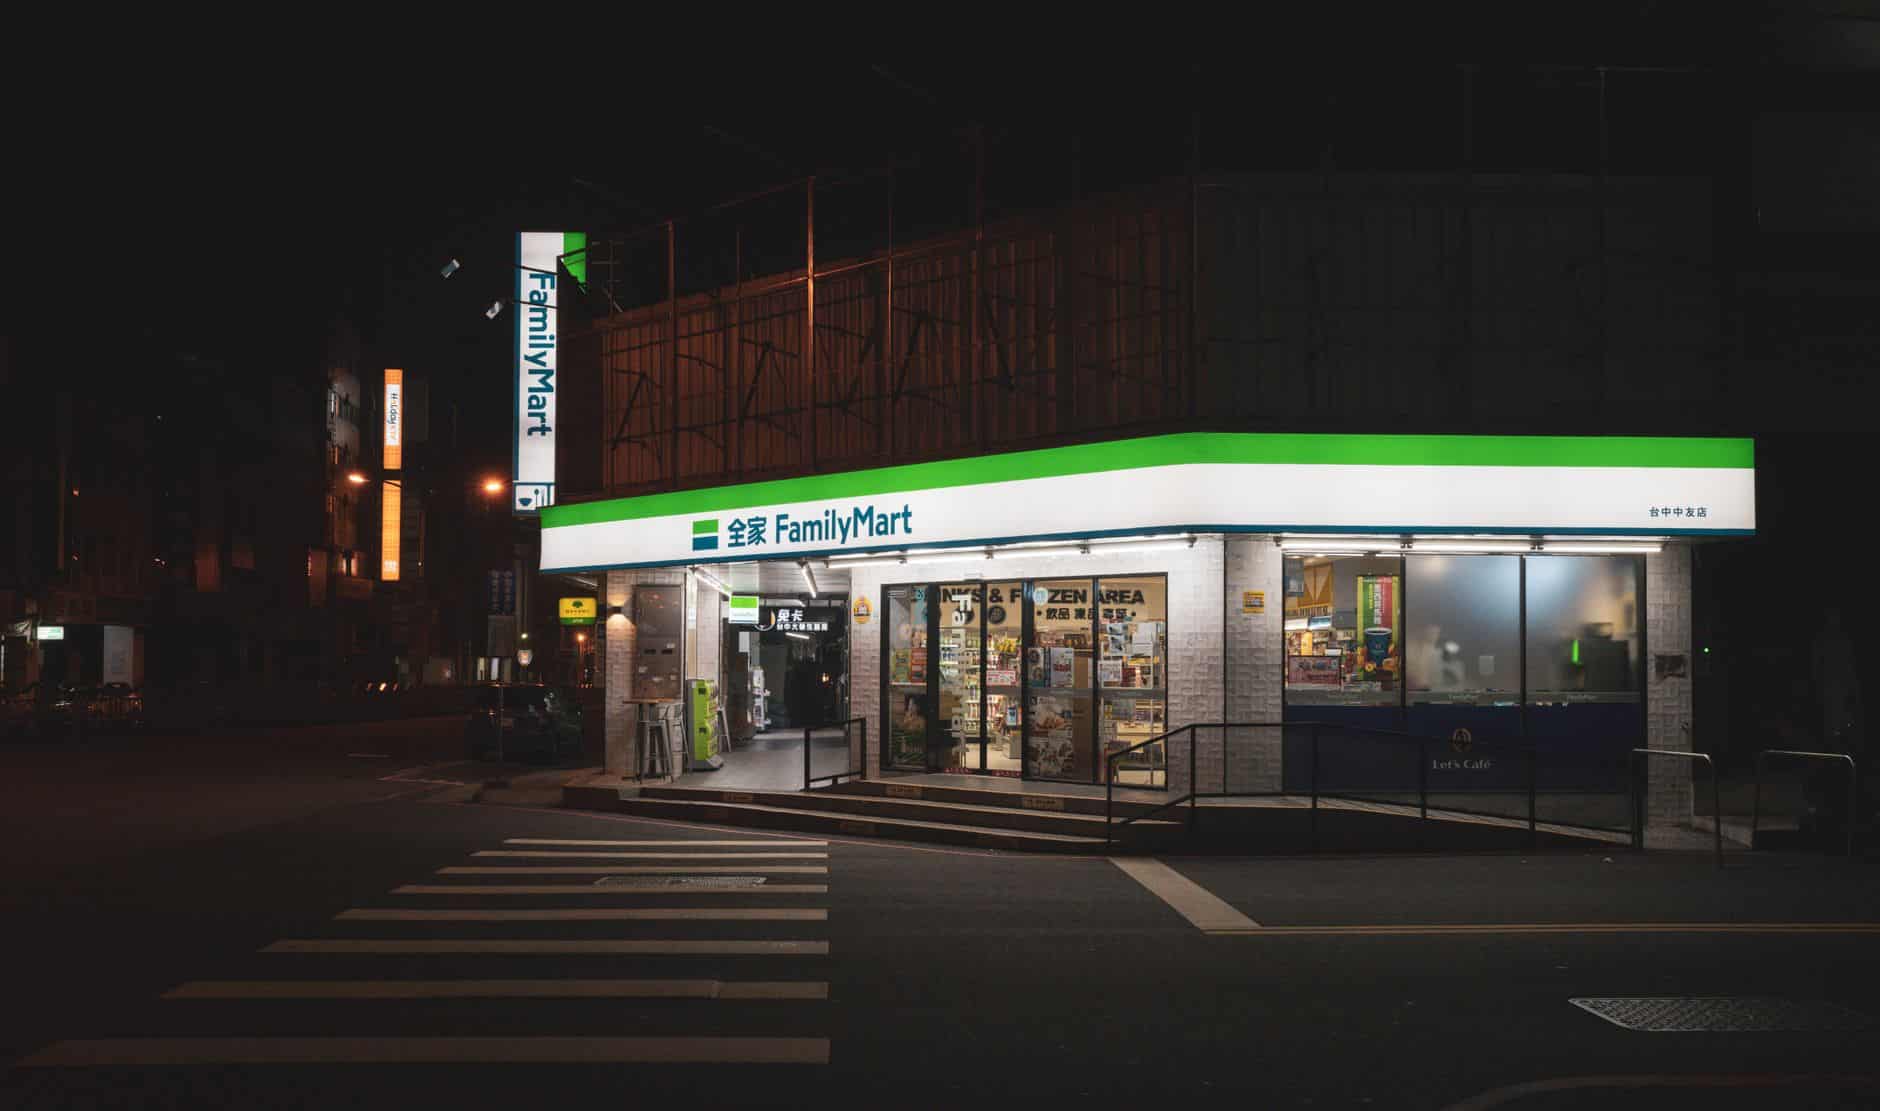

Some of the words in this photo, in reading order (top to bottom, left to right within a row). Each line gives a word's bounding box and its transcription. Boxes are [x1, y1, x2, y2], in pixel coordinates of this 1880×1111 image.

[523, 273, 556, 437] FamilyMart
[727, 516, 767, 548] 全家
[775, 504, 913, 545] FamilyMart
[1648, 506, 1708, 518] 台中中友店
[1010, 588, 1088, 604] FZEN
